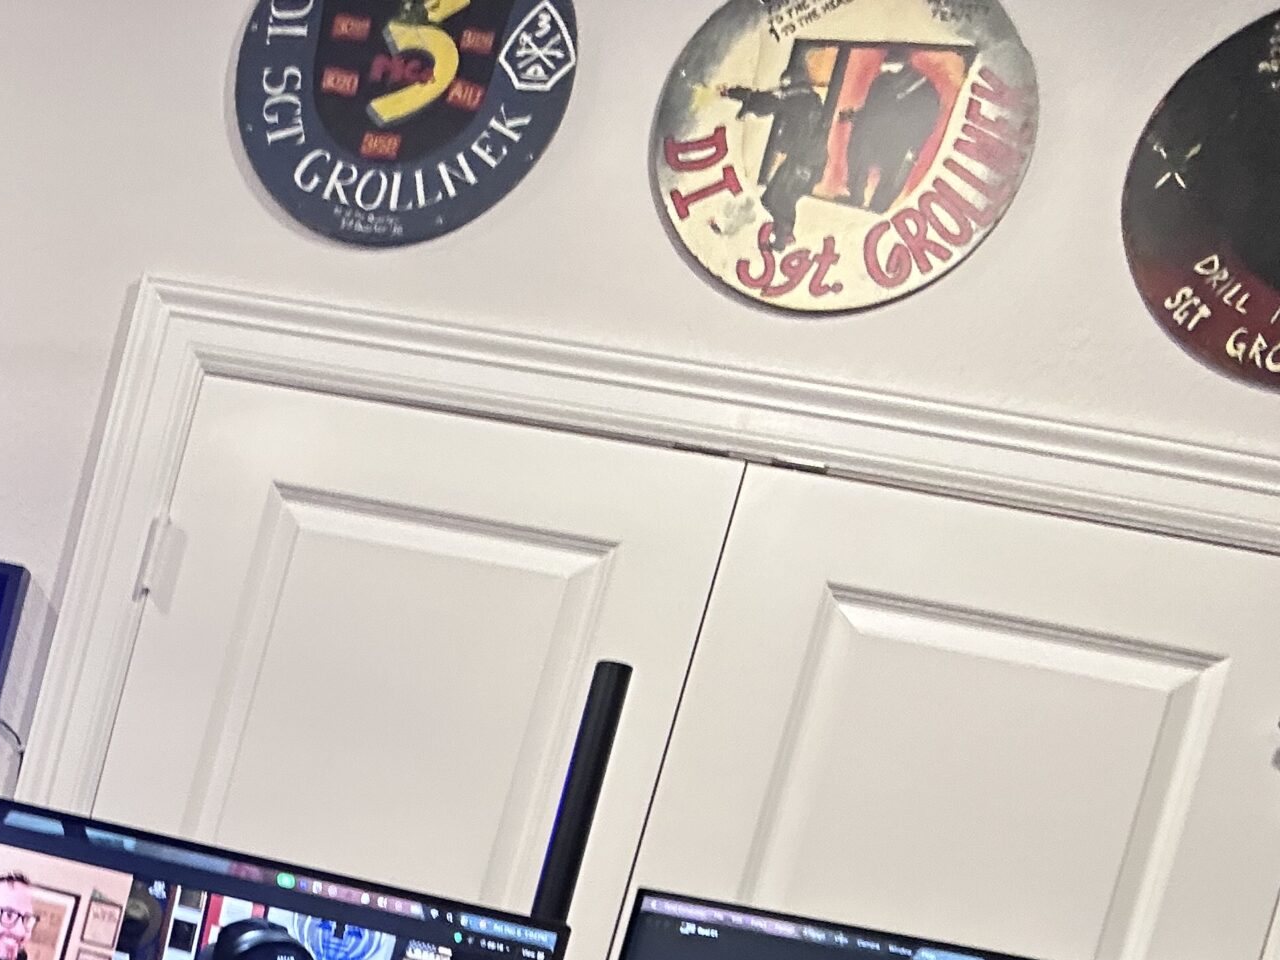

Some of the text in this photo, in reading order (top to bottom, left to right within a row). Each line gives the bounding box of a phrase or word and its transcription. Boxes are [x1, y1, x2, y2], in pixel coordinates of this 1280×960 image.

[263, 66, 305, 146] SGT
[293, 103, 533, 211] GROLLNEK
[664, 126, 743, 219] DI
[1164, 286, 1212, 331] SGT
[1193, 254, 1250, 315] DRILL
